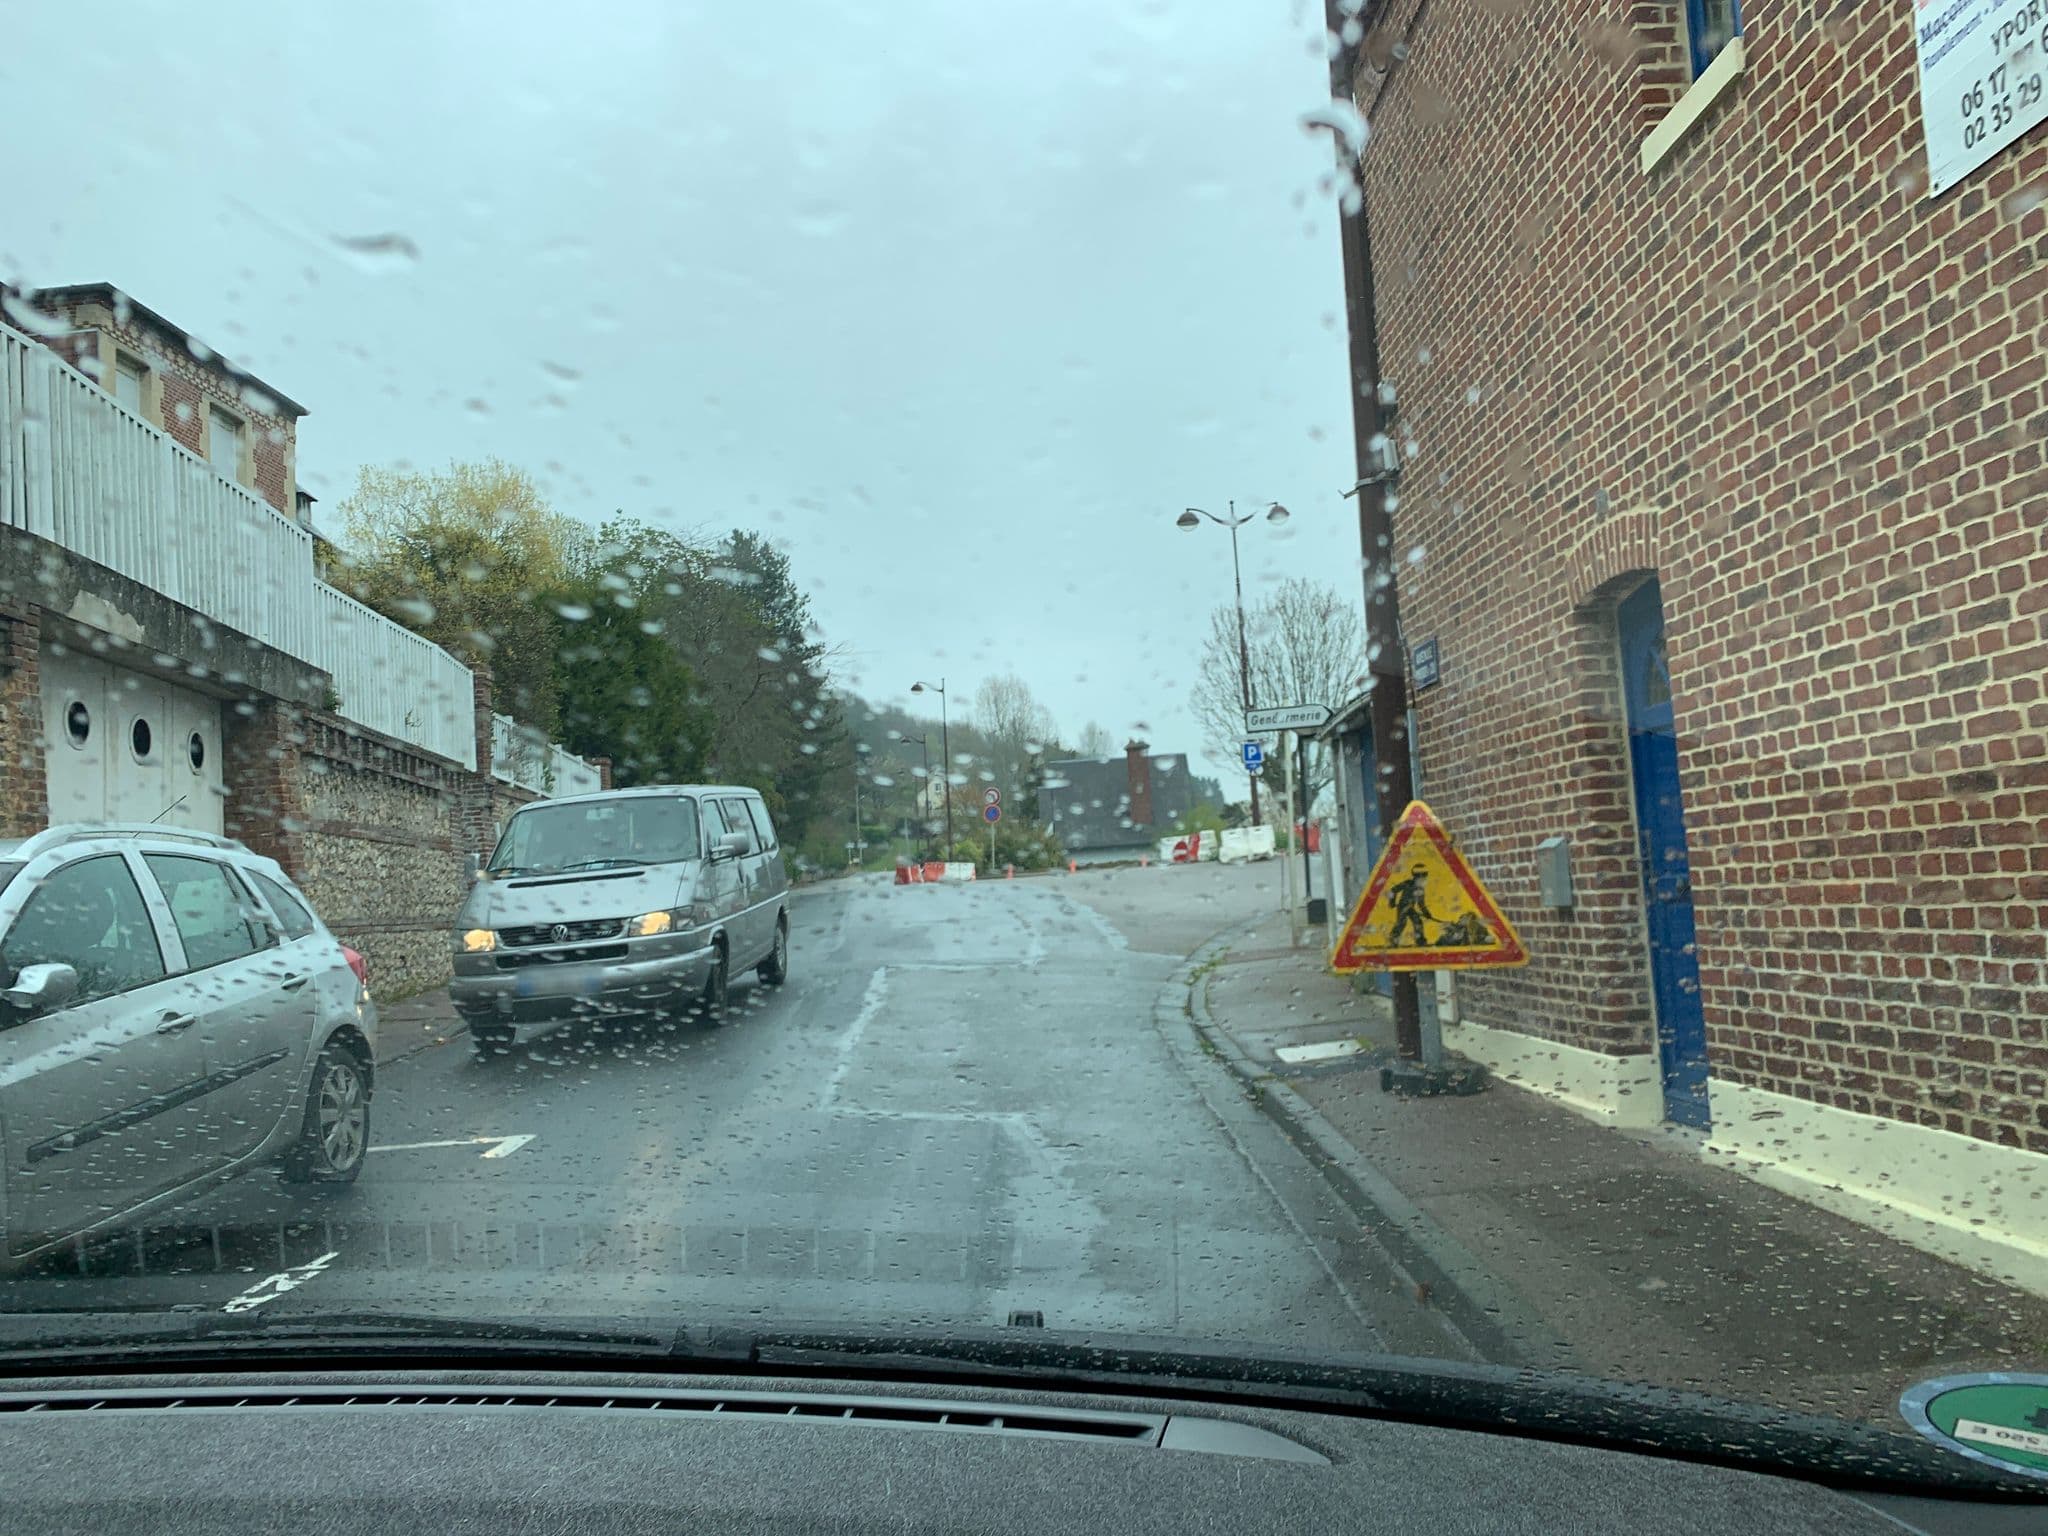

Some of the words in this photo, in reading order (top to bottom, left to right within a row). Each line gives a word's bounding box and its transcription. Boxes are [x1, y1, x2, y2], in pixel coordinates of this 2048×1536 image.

[1962, 80, 1984, 118] 06
[1988, 62, 2007, 96] 17
[1964, 116, 1987, 149] 02
[1991, 93, 2013, 133] 35
[2017, 73, 2042, 109] 29
[1251, 711, 1321, 726] Gendrmerie
[1248, 746, 1257, 759] P
